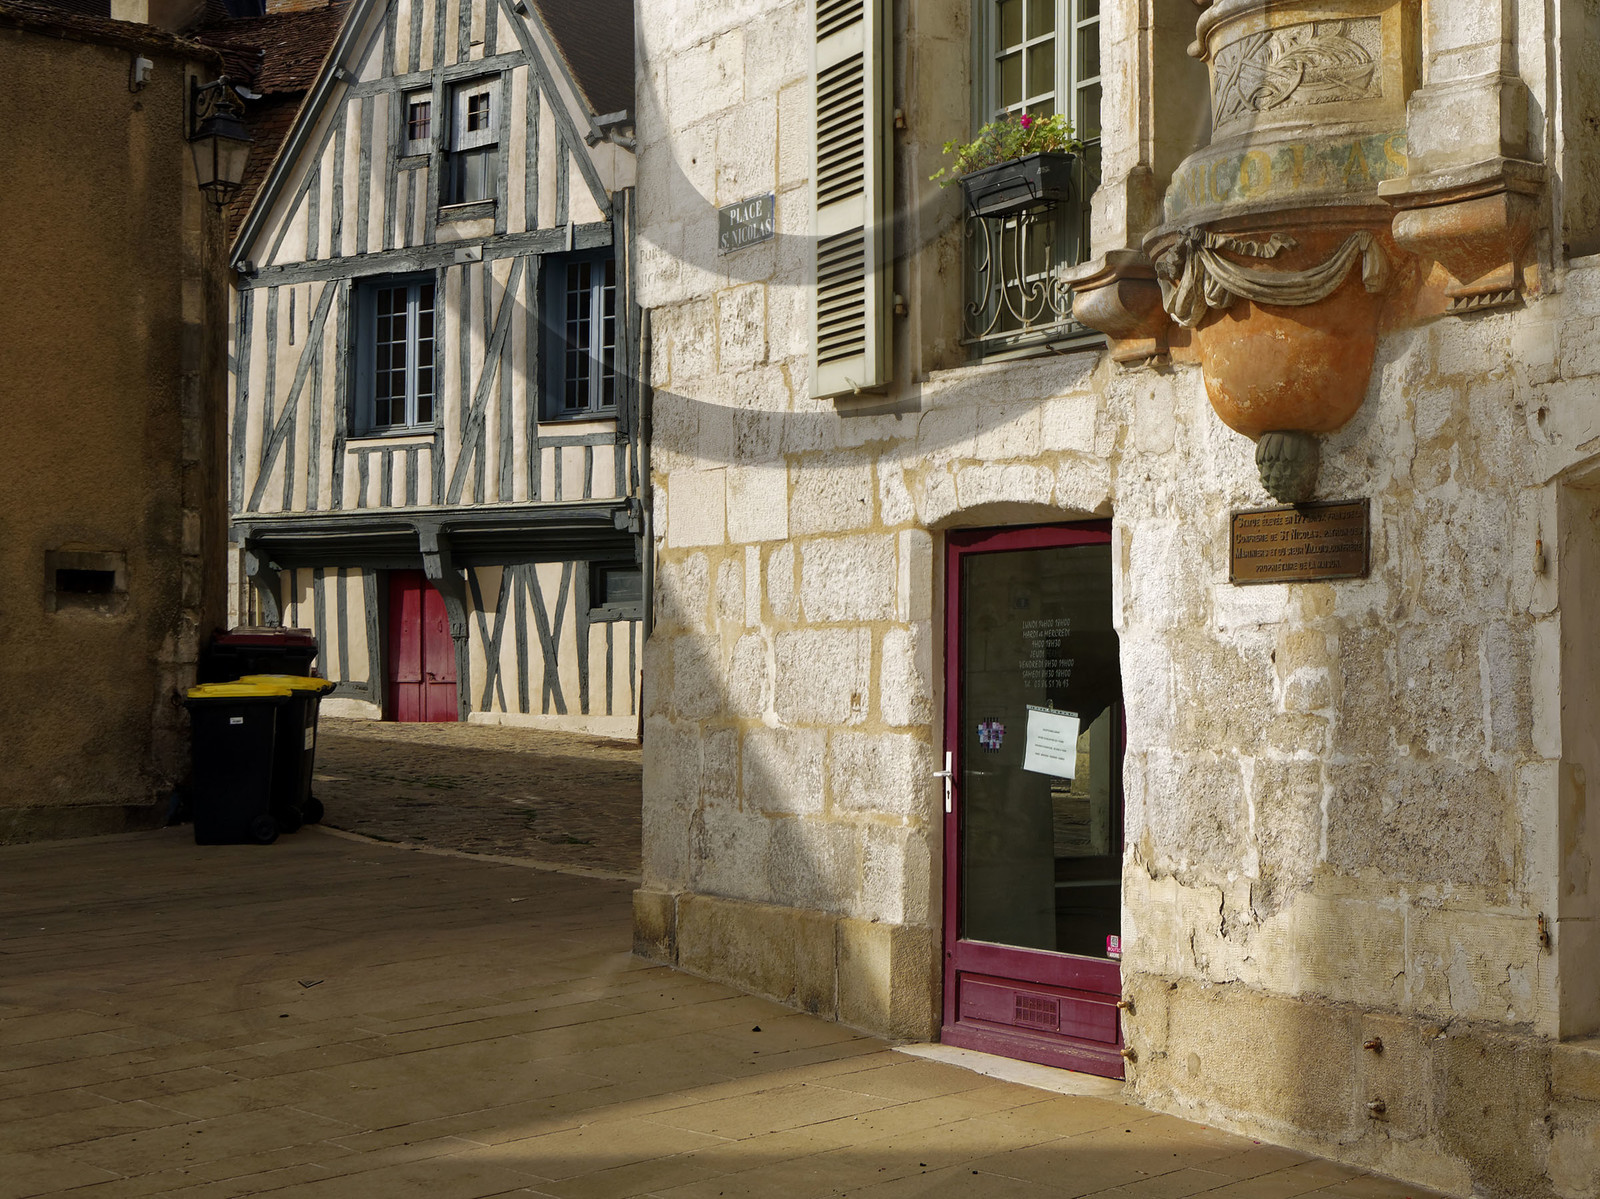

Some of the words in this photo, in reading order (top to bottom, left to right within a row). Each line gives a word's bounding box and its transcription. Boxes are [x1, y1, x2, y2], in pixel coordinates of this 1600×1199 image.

[730, 200, 763, 226] PLACE
[732, 218, 772, 246] NICOLAS
[1238, 517, 1260, 529] STATUE
[1262, 514, 1284, 527] ÉLEVÉE
[1285, 515, 1293, 525] EN
[1270, 533, 1278, 542] DE
[1235, 547, 1269, 559] MARINIERS
[1270, 547, 1278, 557] ET
[1278, 547, 1286, 556] DU
[1287, 546, 1304, 556] SIEUR
[1255, 559, 1298, 573] PROPRIÉTAIRE
[1299, 561, 1308, 570] DE
[1022, 620, 1038, 629] LUNDI
[1022, 630, 1039, 639] MARDI
[1043, 628, 1071, 638] MERCREDI
[1030, 649, 1045, 658] JEUDI
[1019, 659, 1044, 669] VENDREDI
[1022, 669, 1042, 679] SAMEDI
